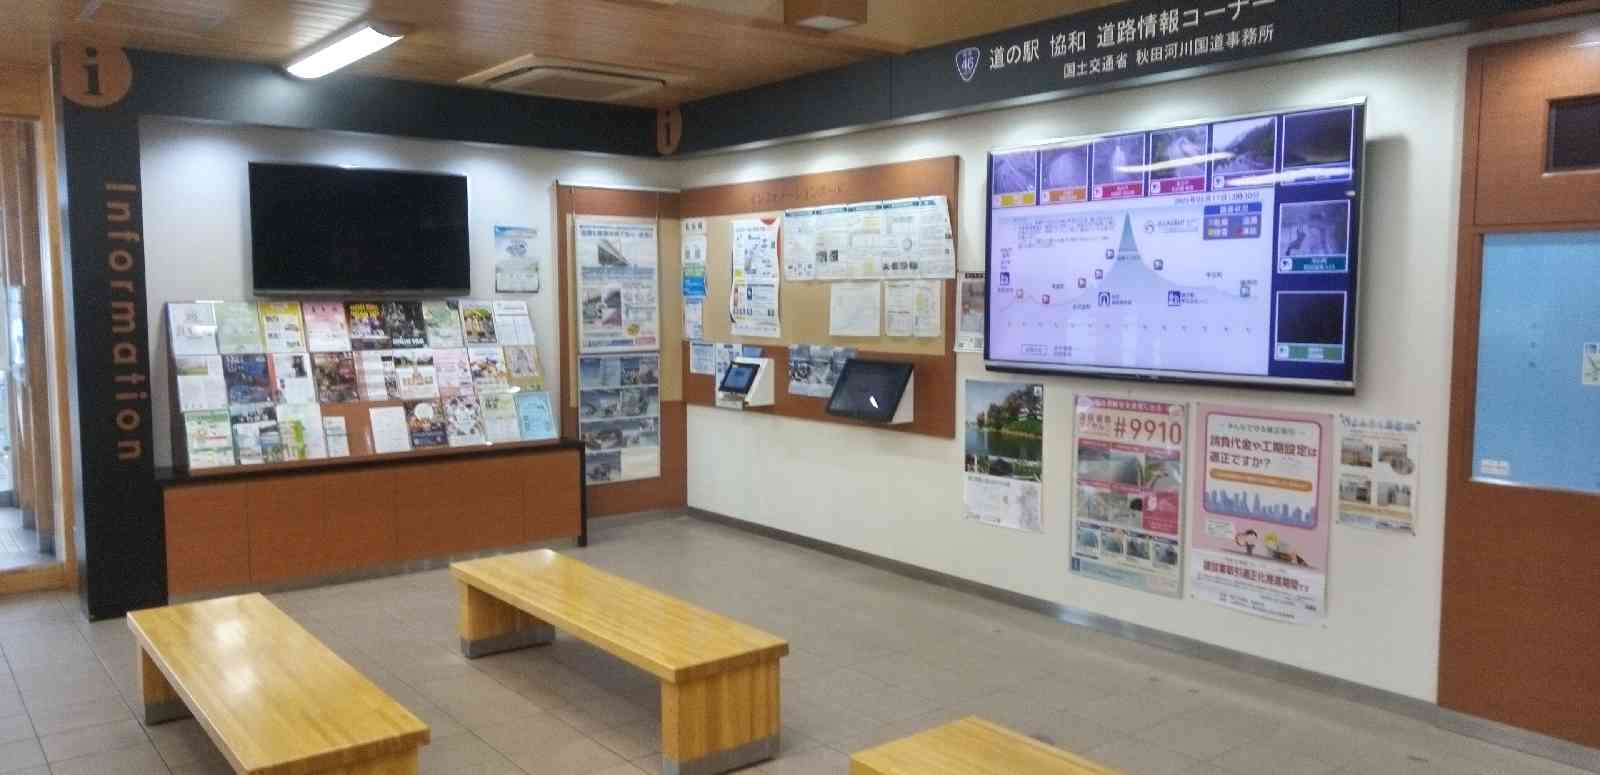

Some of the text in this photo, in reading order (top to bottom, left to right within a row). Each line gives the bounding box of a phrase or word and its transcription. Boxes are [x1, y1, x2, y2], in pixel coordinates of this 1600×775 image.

[989, 0, 1276, 70] 道の駅 協和 道路情報コーナー
[1063, 24, 1274, 79] 国土交通省 秋田河川国道事務所
[105, 182, 148, 462] Information
[1113, 415, 1182, 446] #9910
[1210, 434, 1317, 457] 請負代金や工期設定は
